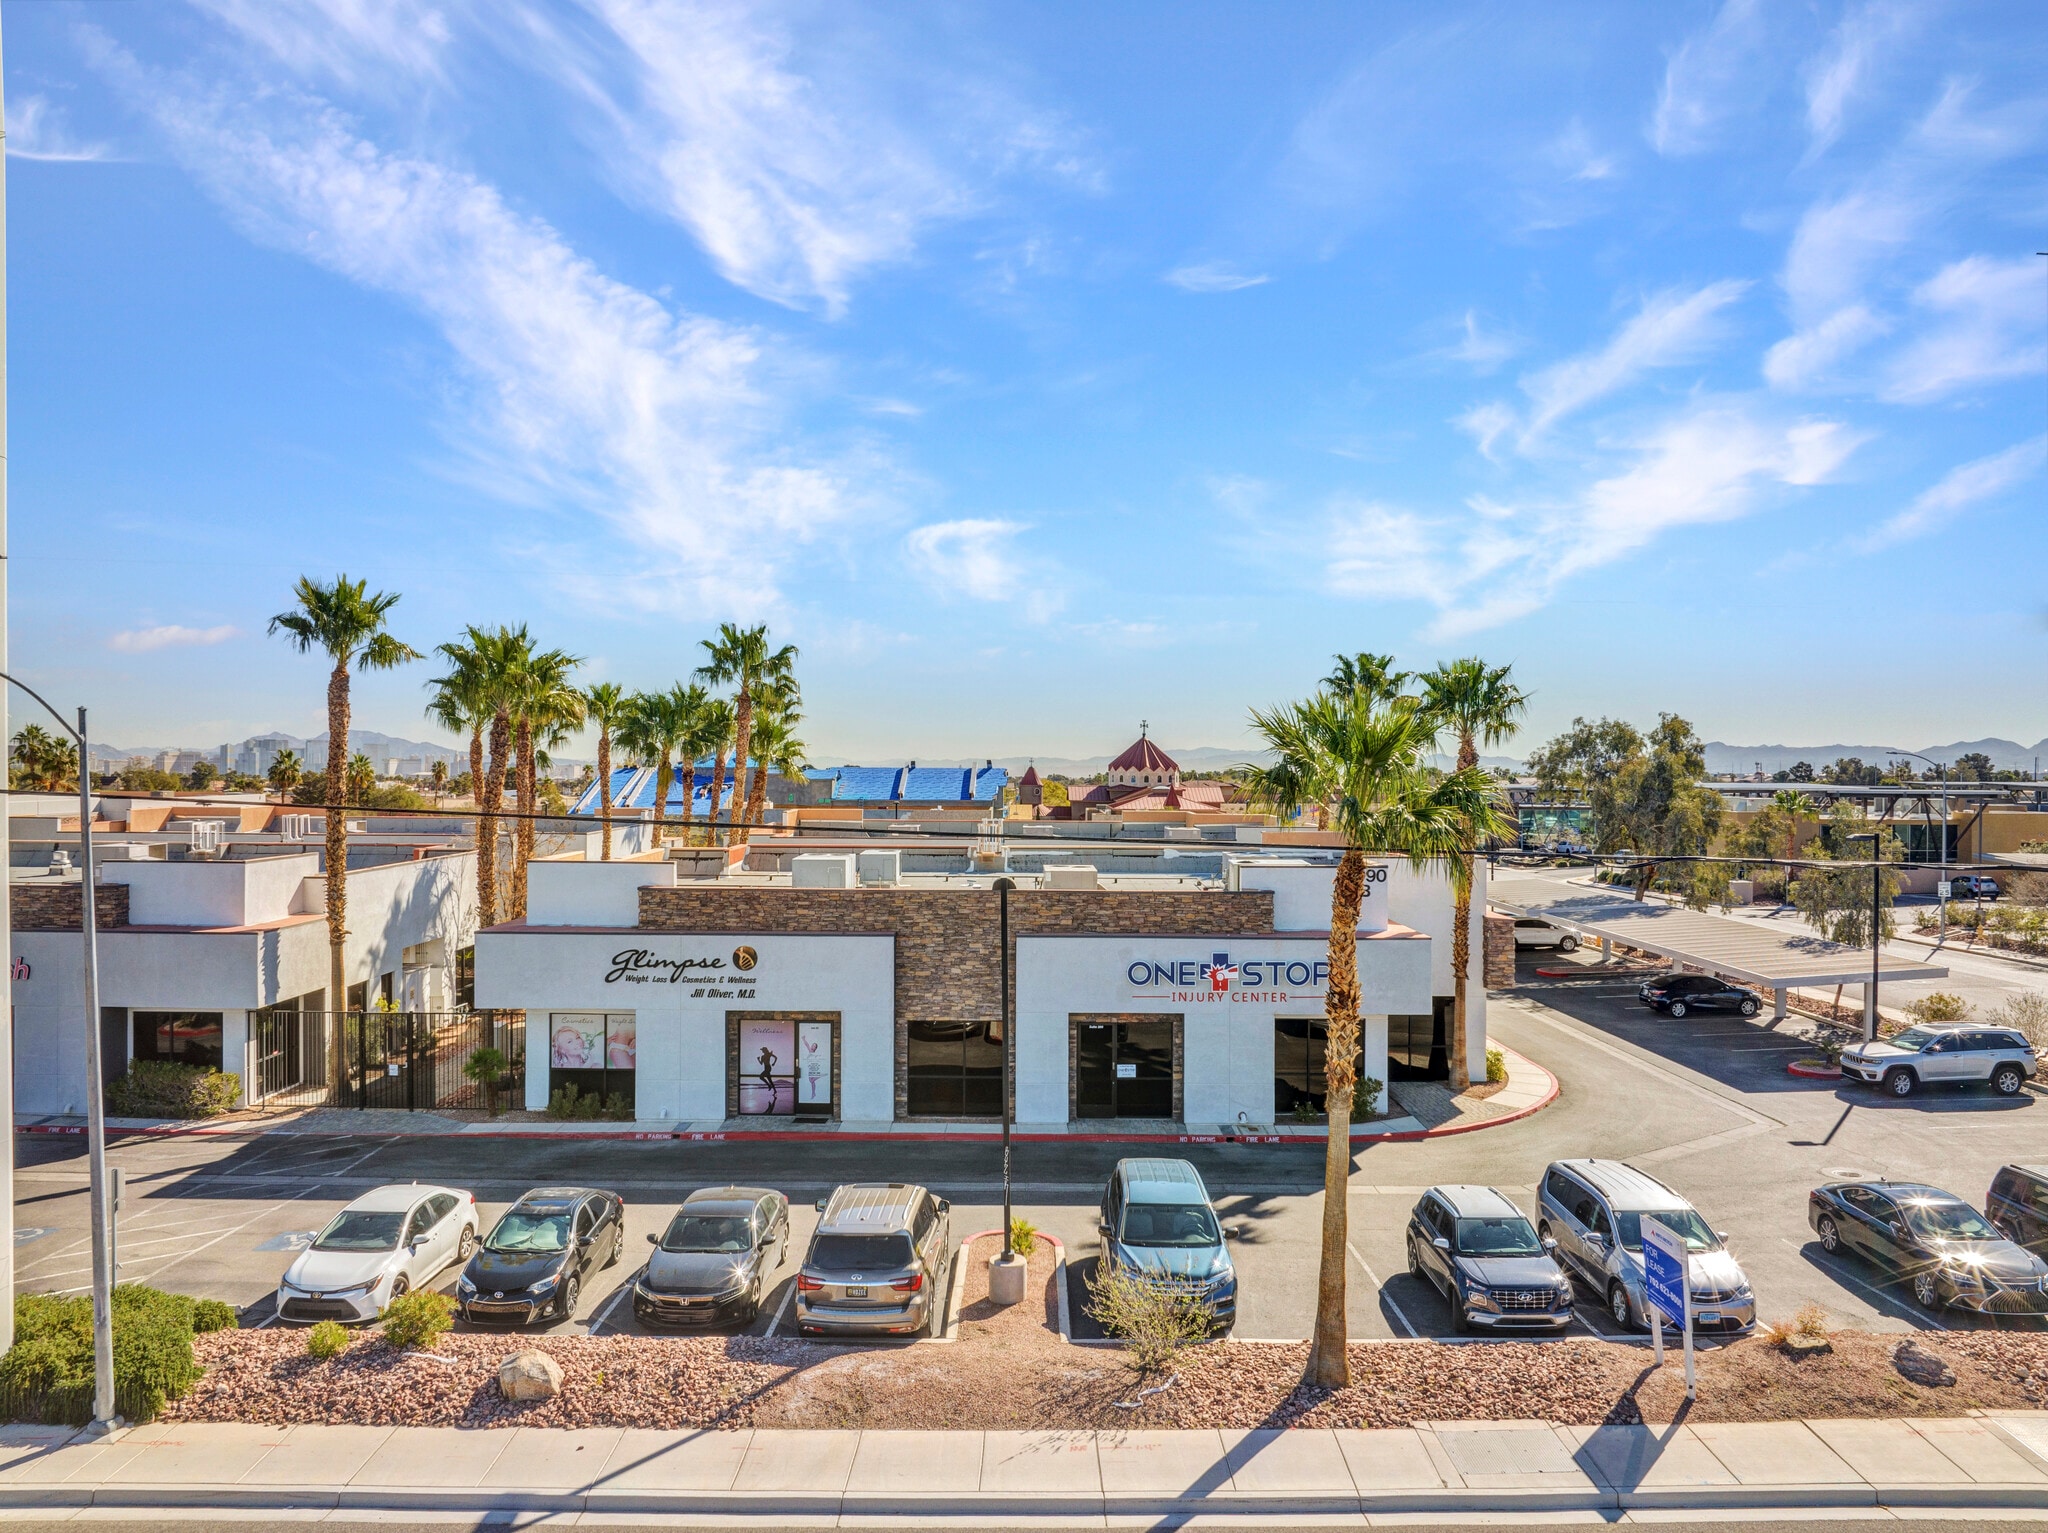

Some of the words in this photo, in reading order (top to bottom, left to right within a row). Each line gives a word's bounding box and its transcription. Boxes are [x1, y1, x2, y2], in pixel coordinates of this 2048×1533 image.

[625, 975, 649, 984] Weight
[681, 976, 716, 984] Cosmetics
[727, 976, 757, 984] Wellness
[1127, 961, 1197, 987] ONE
[690, 988, 705, 998] Jill
[707, 988, 734, 999] Oliver,
[737, 988, 756, 998] M.D.
[1171, 992, 1225, 1002] INJURY
[1231, 992, 1288, 1002] CENTER
[1645, 1243, 1659, 1260] FOR
[1647, 1258, 1665, 1278] LEASE
